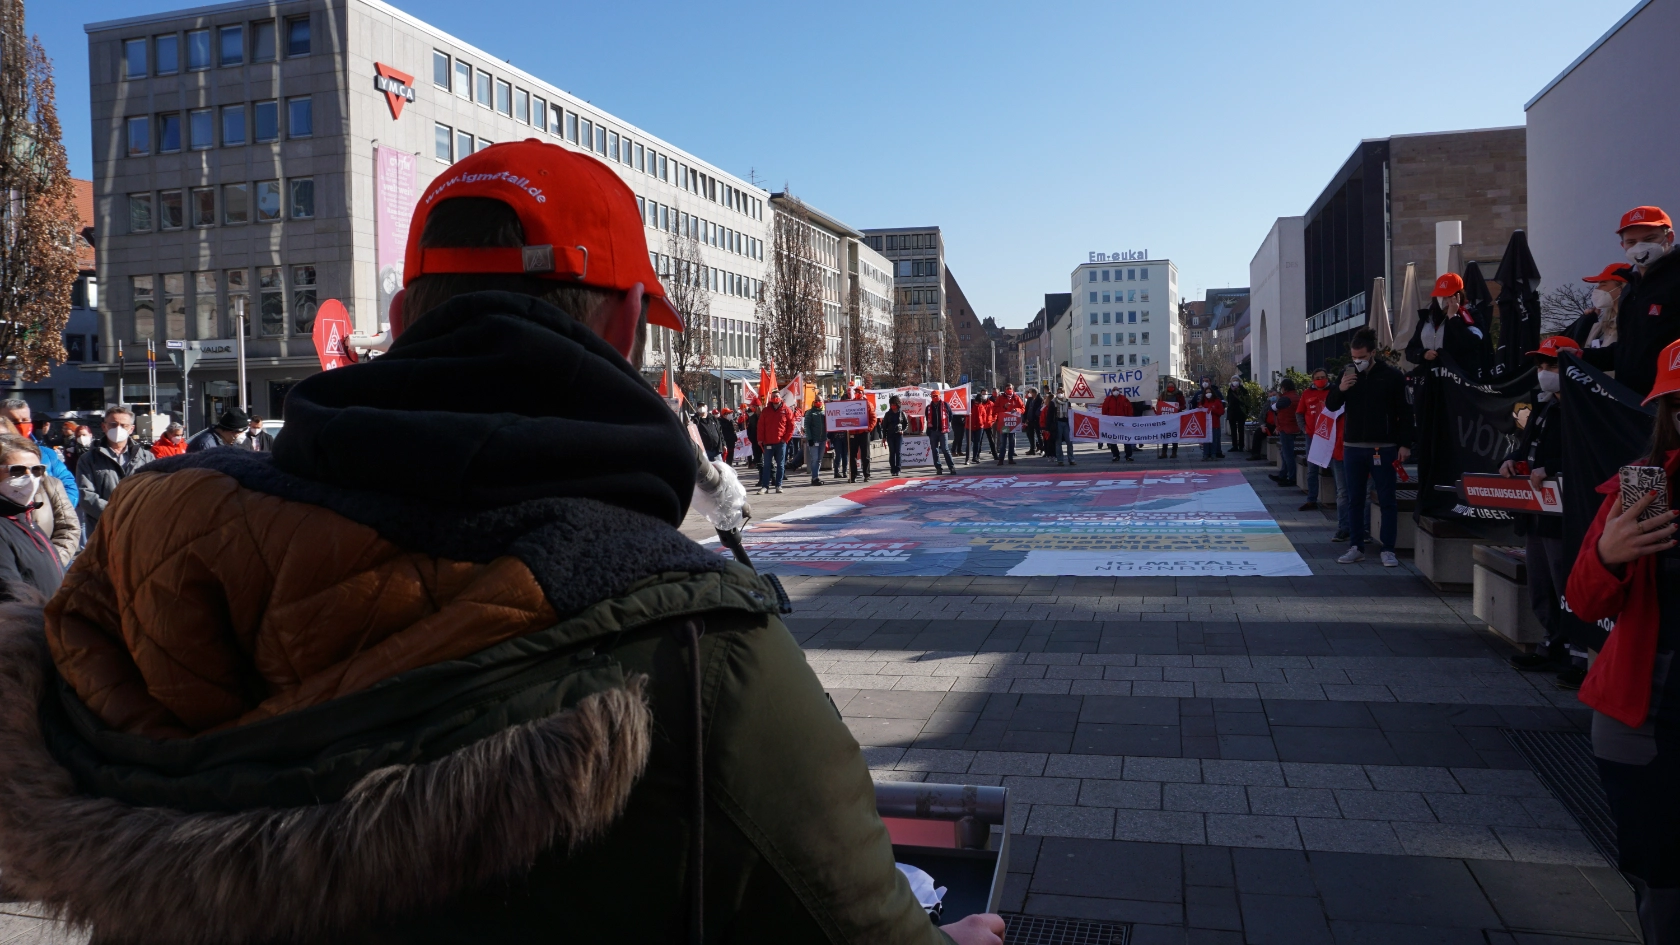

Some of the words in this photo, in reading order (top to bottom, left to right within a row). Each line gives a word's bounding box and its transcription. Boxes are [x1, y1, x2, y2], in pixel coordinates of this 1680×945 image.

[380, 77, 414, 100] YMCA
[425, 171, 546, 205] www.igmetall.de
[1089, 248, 1148, 262] Em-eukal
[1285, 261, 1299, 269] DES
[200, 345, 232, 353] VAUDE
[1100, 369, 1143, 384] TRAFO
[827, 409, 841, 417] WIR
[1131, 420, 1167, 428] Siemens
[1101, 431, 1132, 442] Mobility
[1134, 433, 1159, 441] GmbH
[1160, 431, 1178, 440] NBG
[1466, 486, 1534, 501] ENTGELTAUSGLEICH
